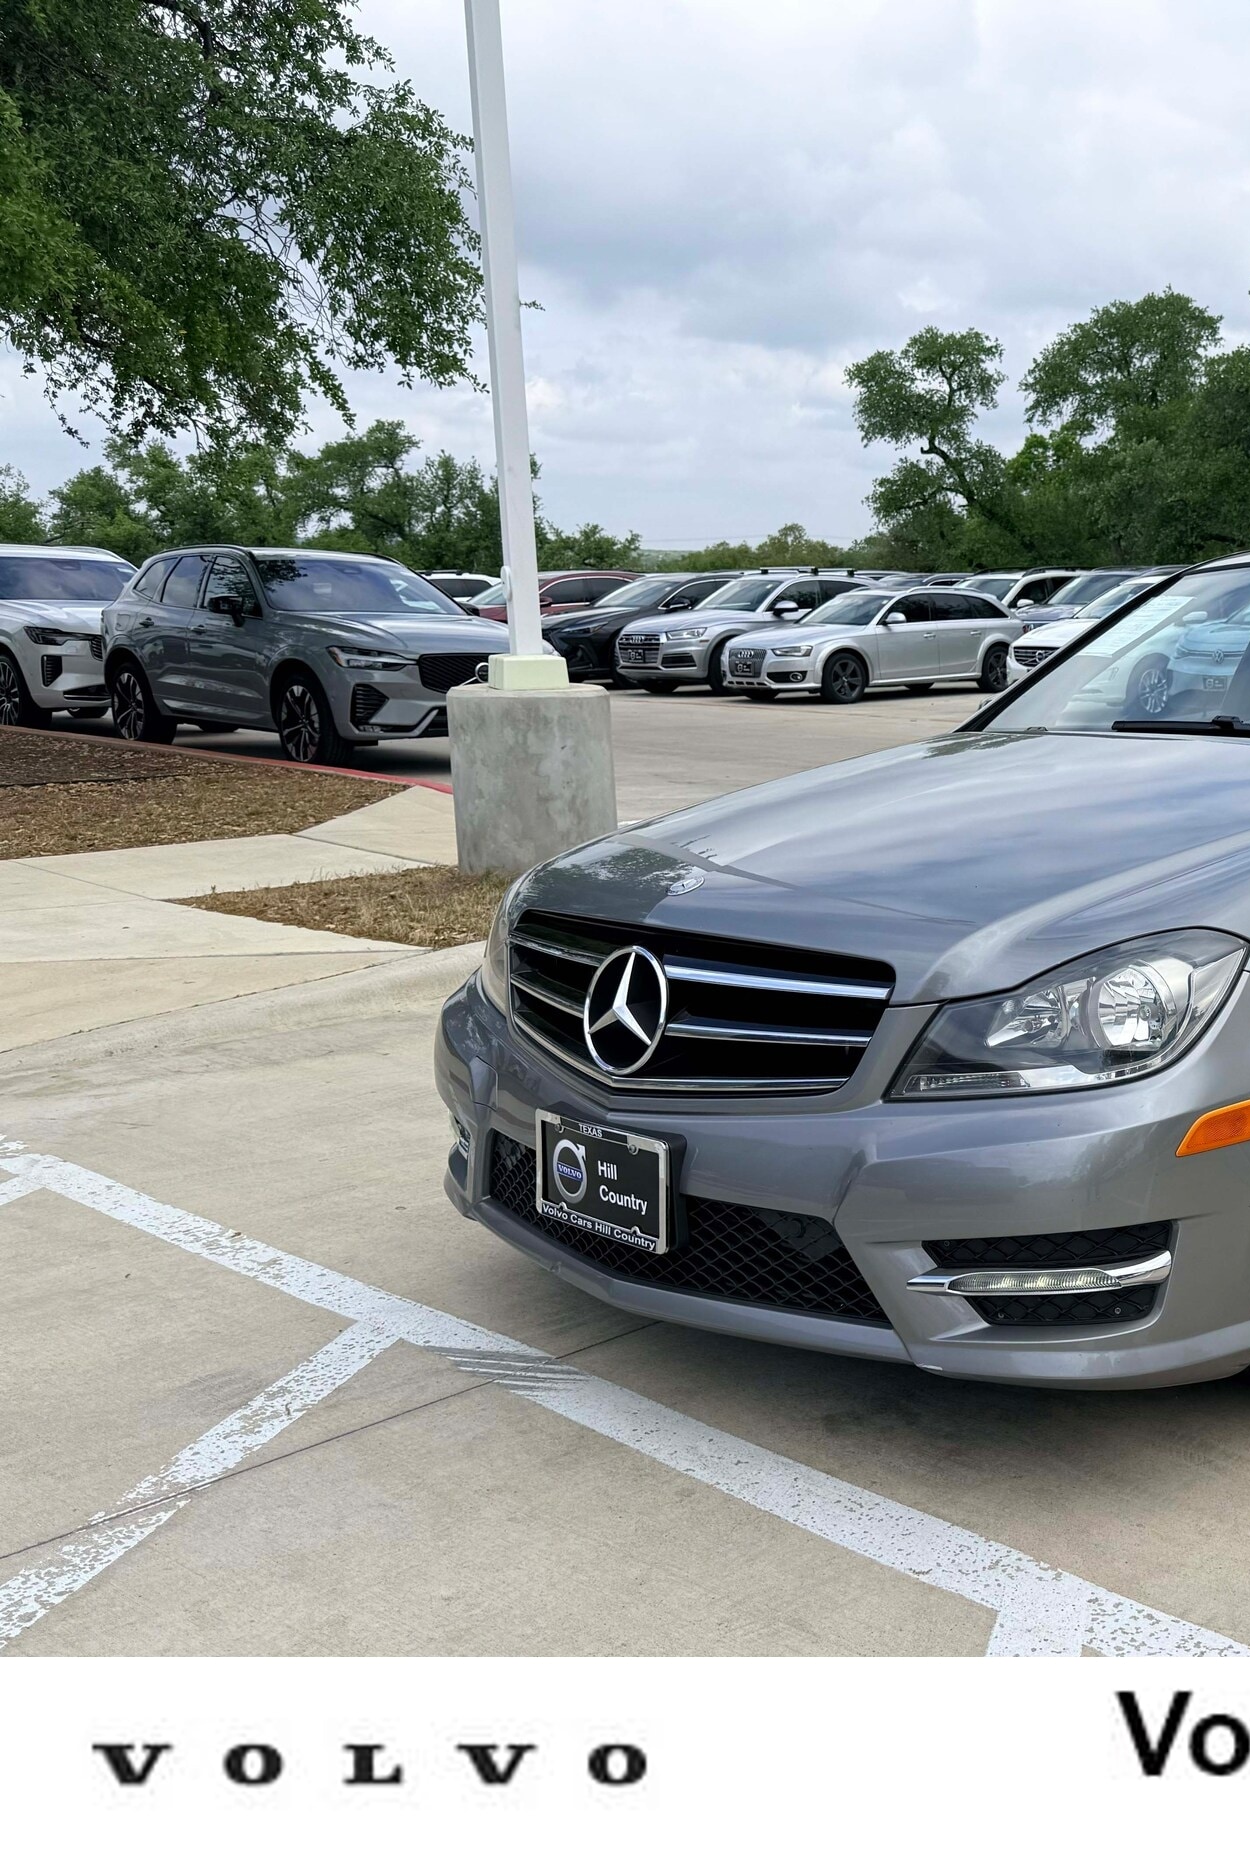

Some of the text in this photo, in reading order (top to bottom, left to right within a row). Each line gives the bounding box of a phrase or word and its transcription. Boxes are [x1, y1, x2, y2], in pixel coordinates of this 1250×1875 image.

[579, 1124, 602, 1137] TEXAS
[558, 1164, 582, 1178] VOLVO
[597, 1160, 617, 1180] Hill
[599, 1185, 647, 1215] Country
[542, 1203, 656, 1251] Volvo Cars Hill Country
